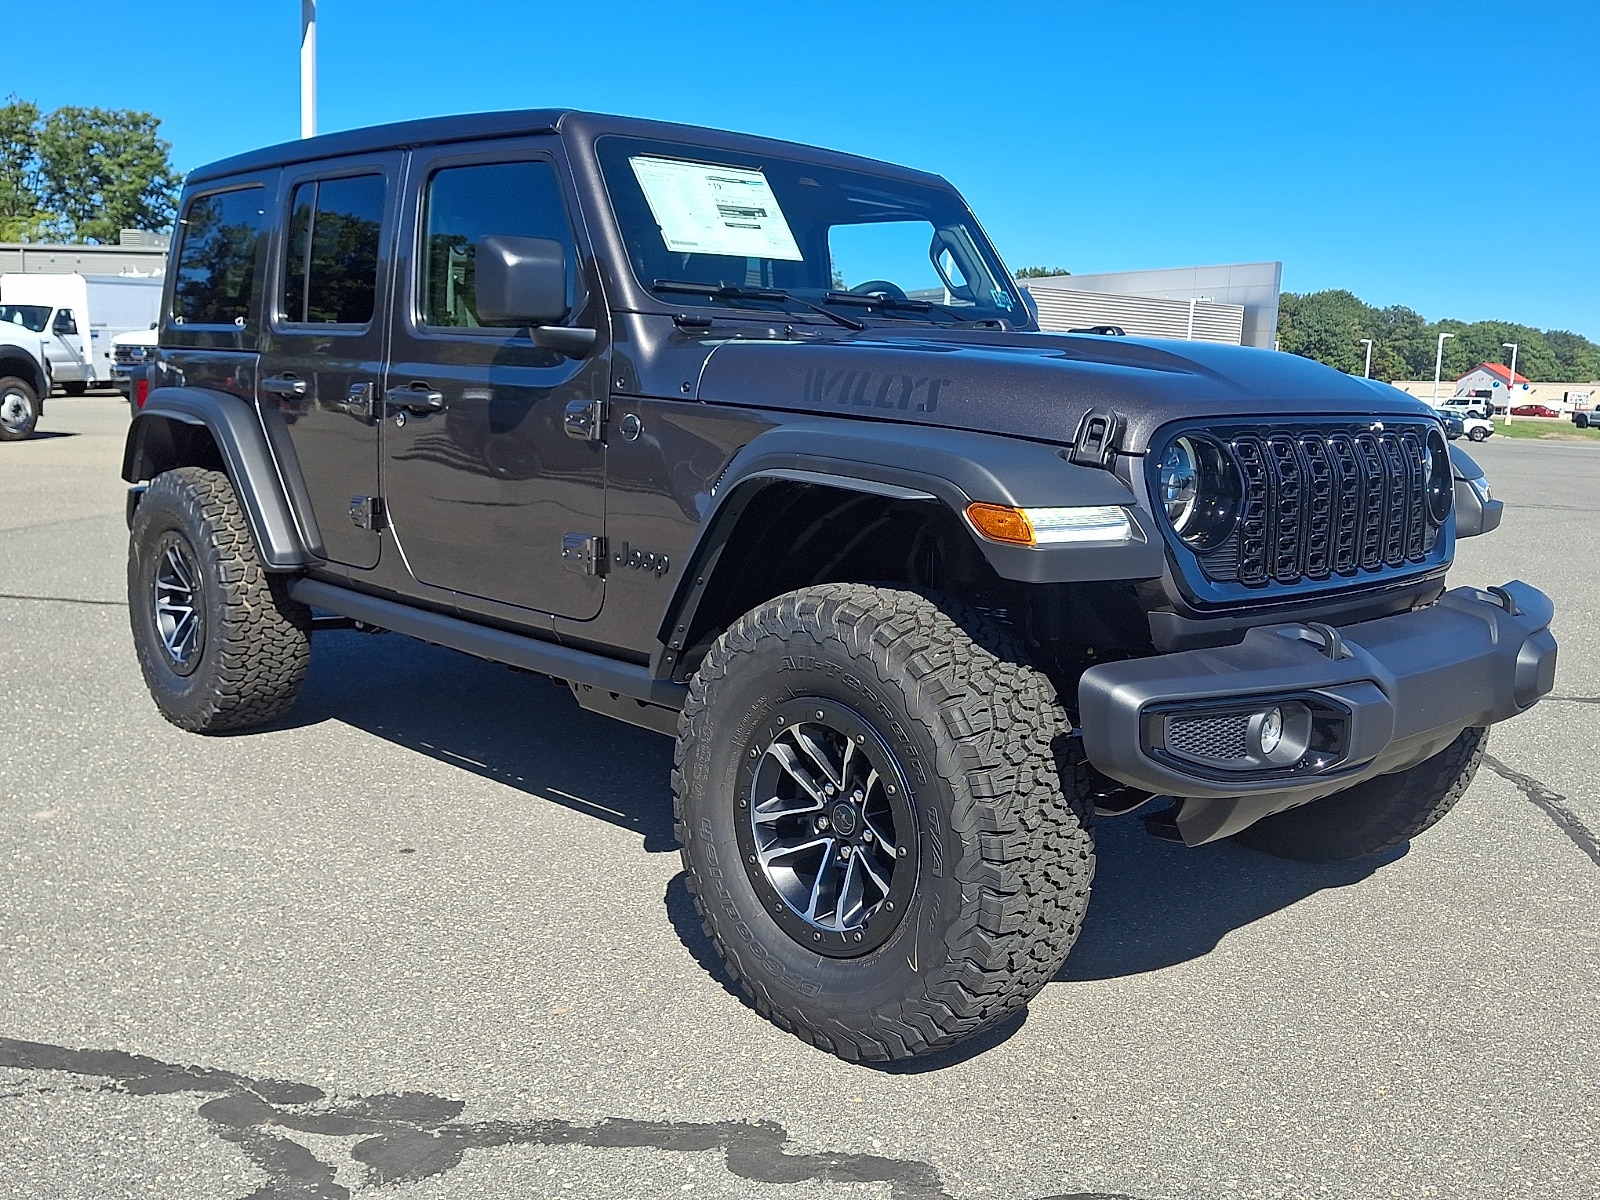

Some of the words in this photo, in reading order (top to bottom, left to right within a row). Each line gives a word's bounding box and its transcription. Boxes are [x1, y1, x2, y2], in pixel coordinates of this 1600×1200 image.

[804, 368, 952, 413] WILLYS
[614, 540, 670, 580] Jeep
[926, 806, 944, 878] T/A
[698, 816, 823, 999] BFGoodrich
